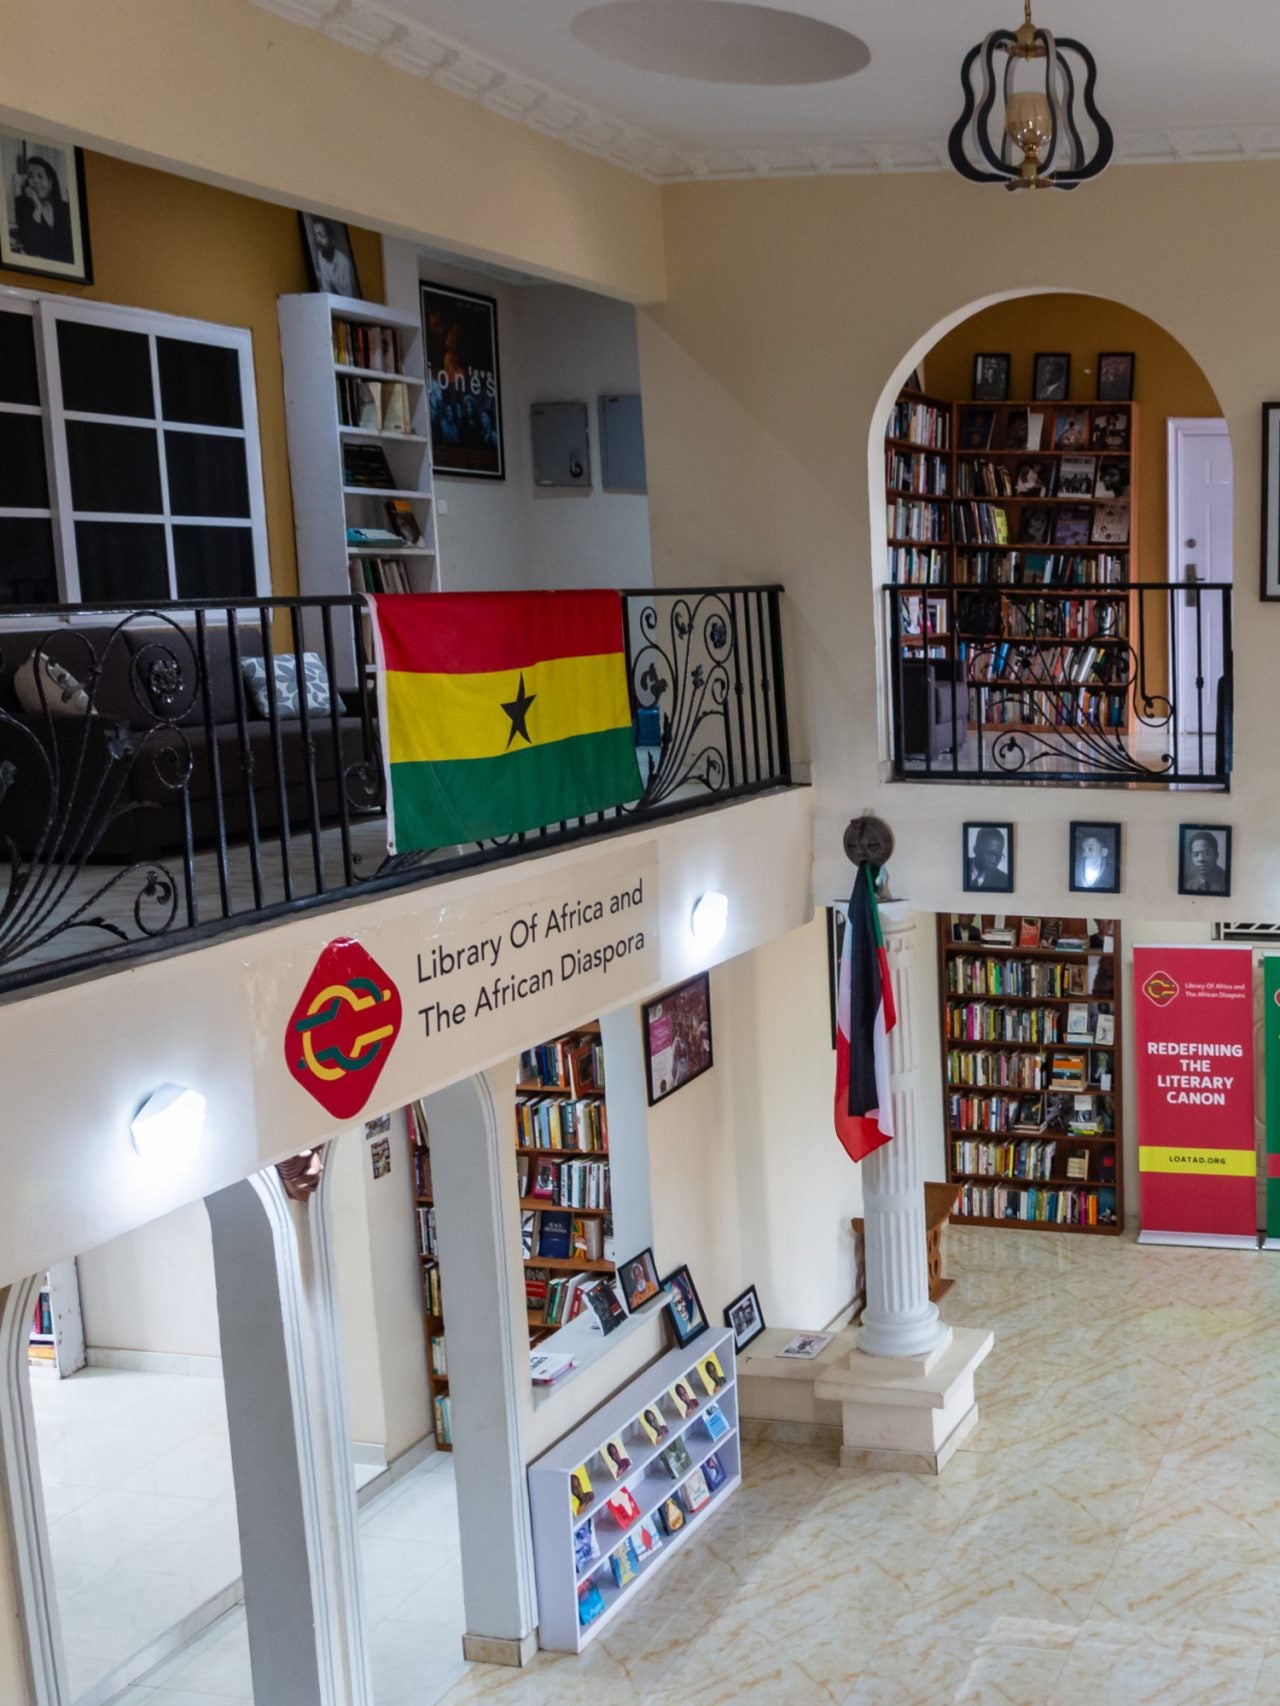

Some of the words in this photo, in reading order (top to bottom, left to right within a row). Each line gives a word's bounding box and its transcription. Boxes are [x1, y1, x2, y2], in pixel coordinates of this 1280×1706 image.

[417, 935, 502, 983] Library
[510, 914, 538, 949] Of
[545, 899, 604, 939] Africa
[610, 878, 644, 914] and
[418, 1003, 466, 1037] The
[475, 969, 554, 1018] African
[561, 931, 645, 982] Diaspora
[1147, 1042, 1243, 1057] REDEFINING
[1179, 1059, 1211, 1072] THE
[1157, 1075, 1234, 1089] LITERARY
[1167, 1091, 1226, 1106] CANON
[1169, 1155, 1226, 1165] LOATAD.ORG
